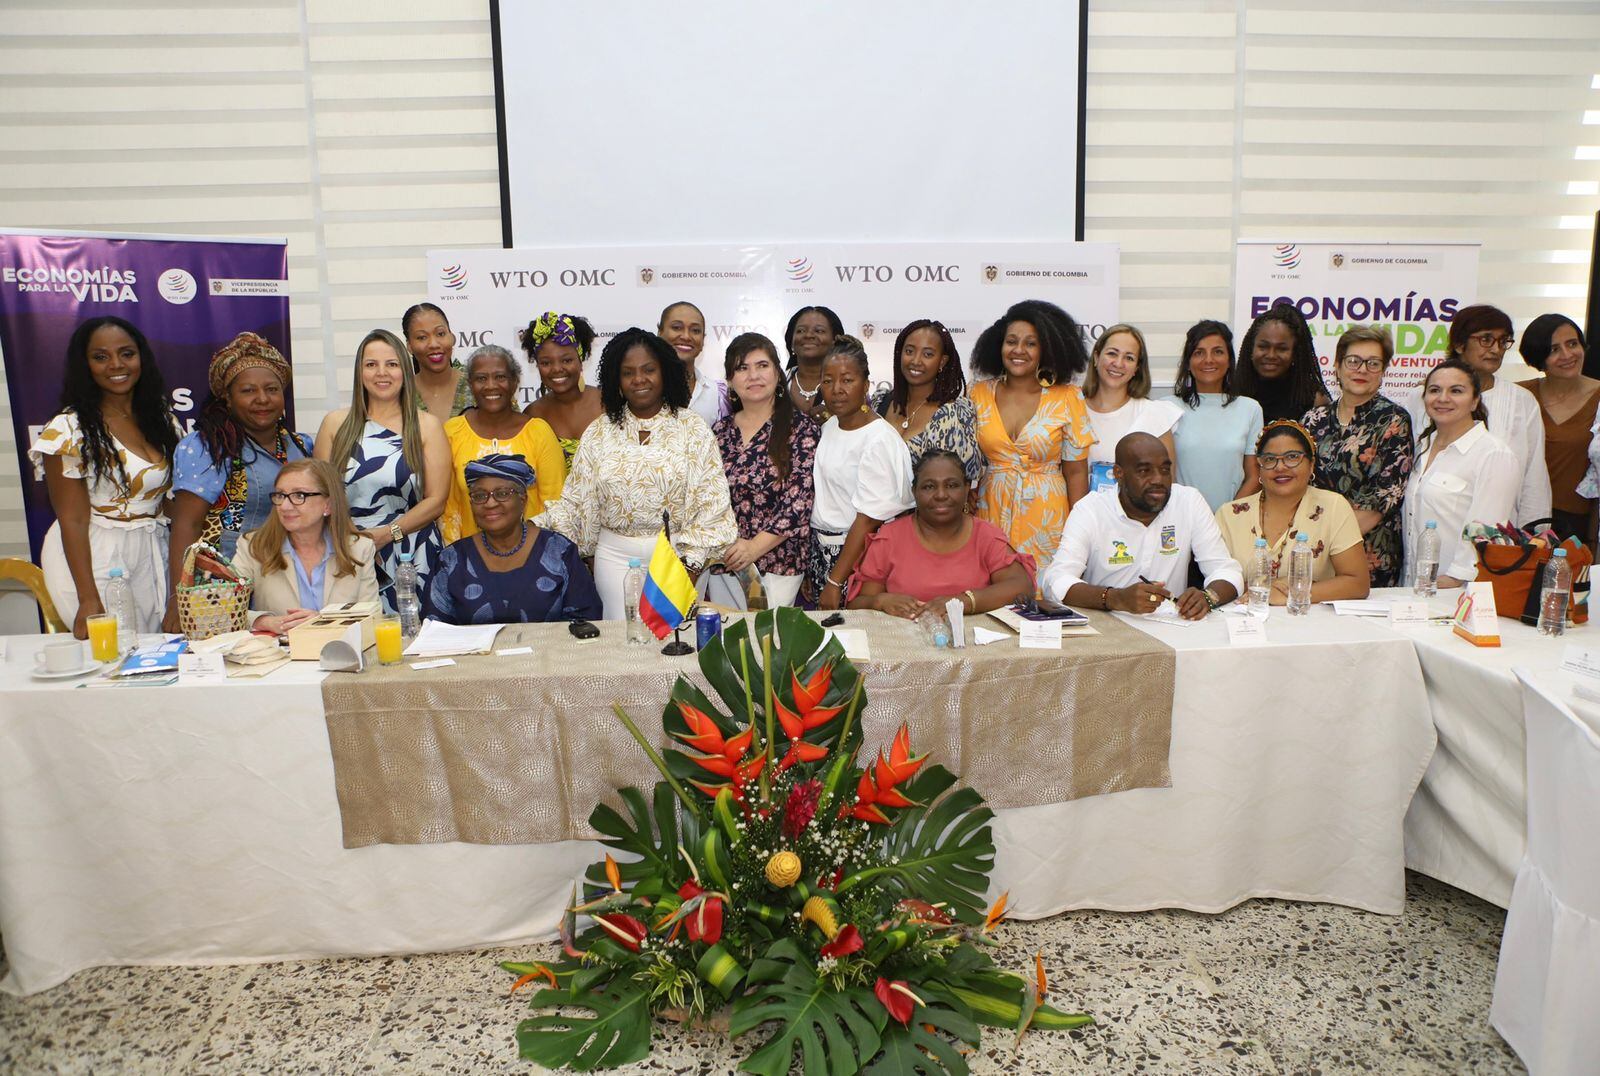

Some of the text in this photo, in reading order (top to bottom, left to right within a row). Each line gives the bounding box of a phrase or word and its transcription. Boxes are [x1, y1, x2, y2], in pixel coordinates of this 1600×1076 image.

[3, 266, 136, 285] ECONOMÍAS
[490, 268, 616, 288] WTO OMC
[835, 265, 960, 282] WTO OMC
[19, 283, 139, 302] PARA LA VIDA
[451, 330, 494, 348] MC
[1075, 324, 1107, 341] TO
[1390, 358, 1445, 367] VENTUR
